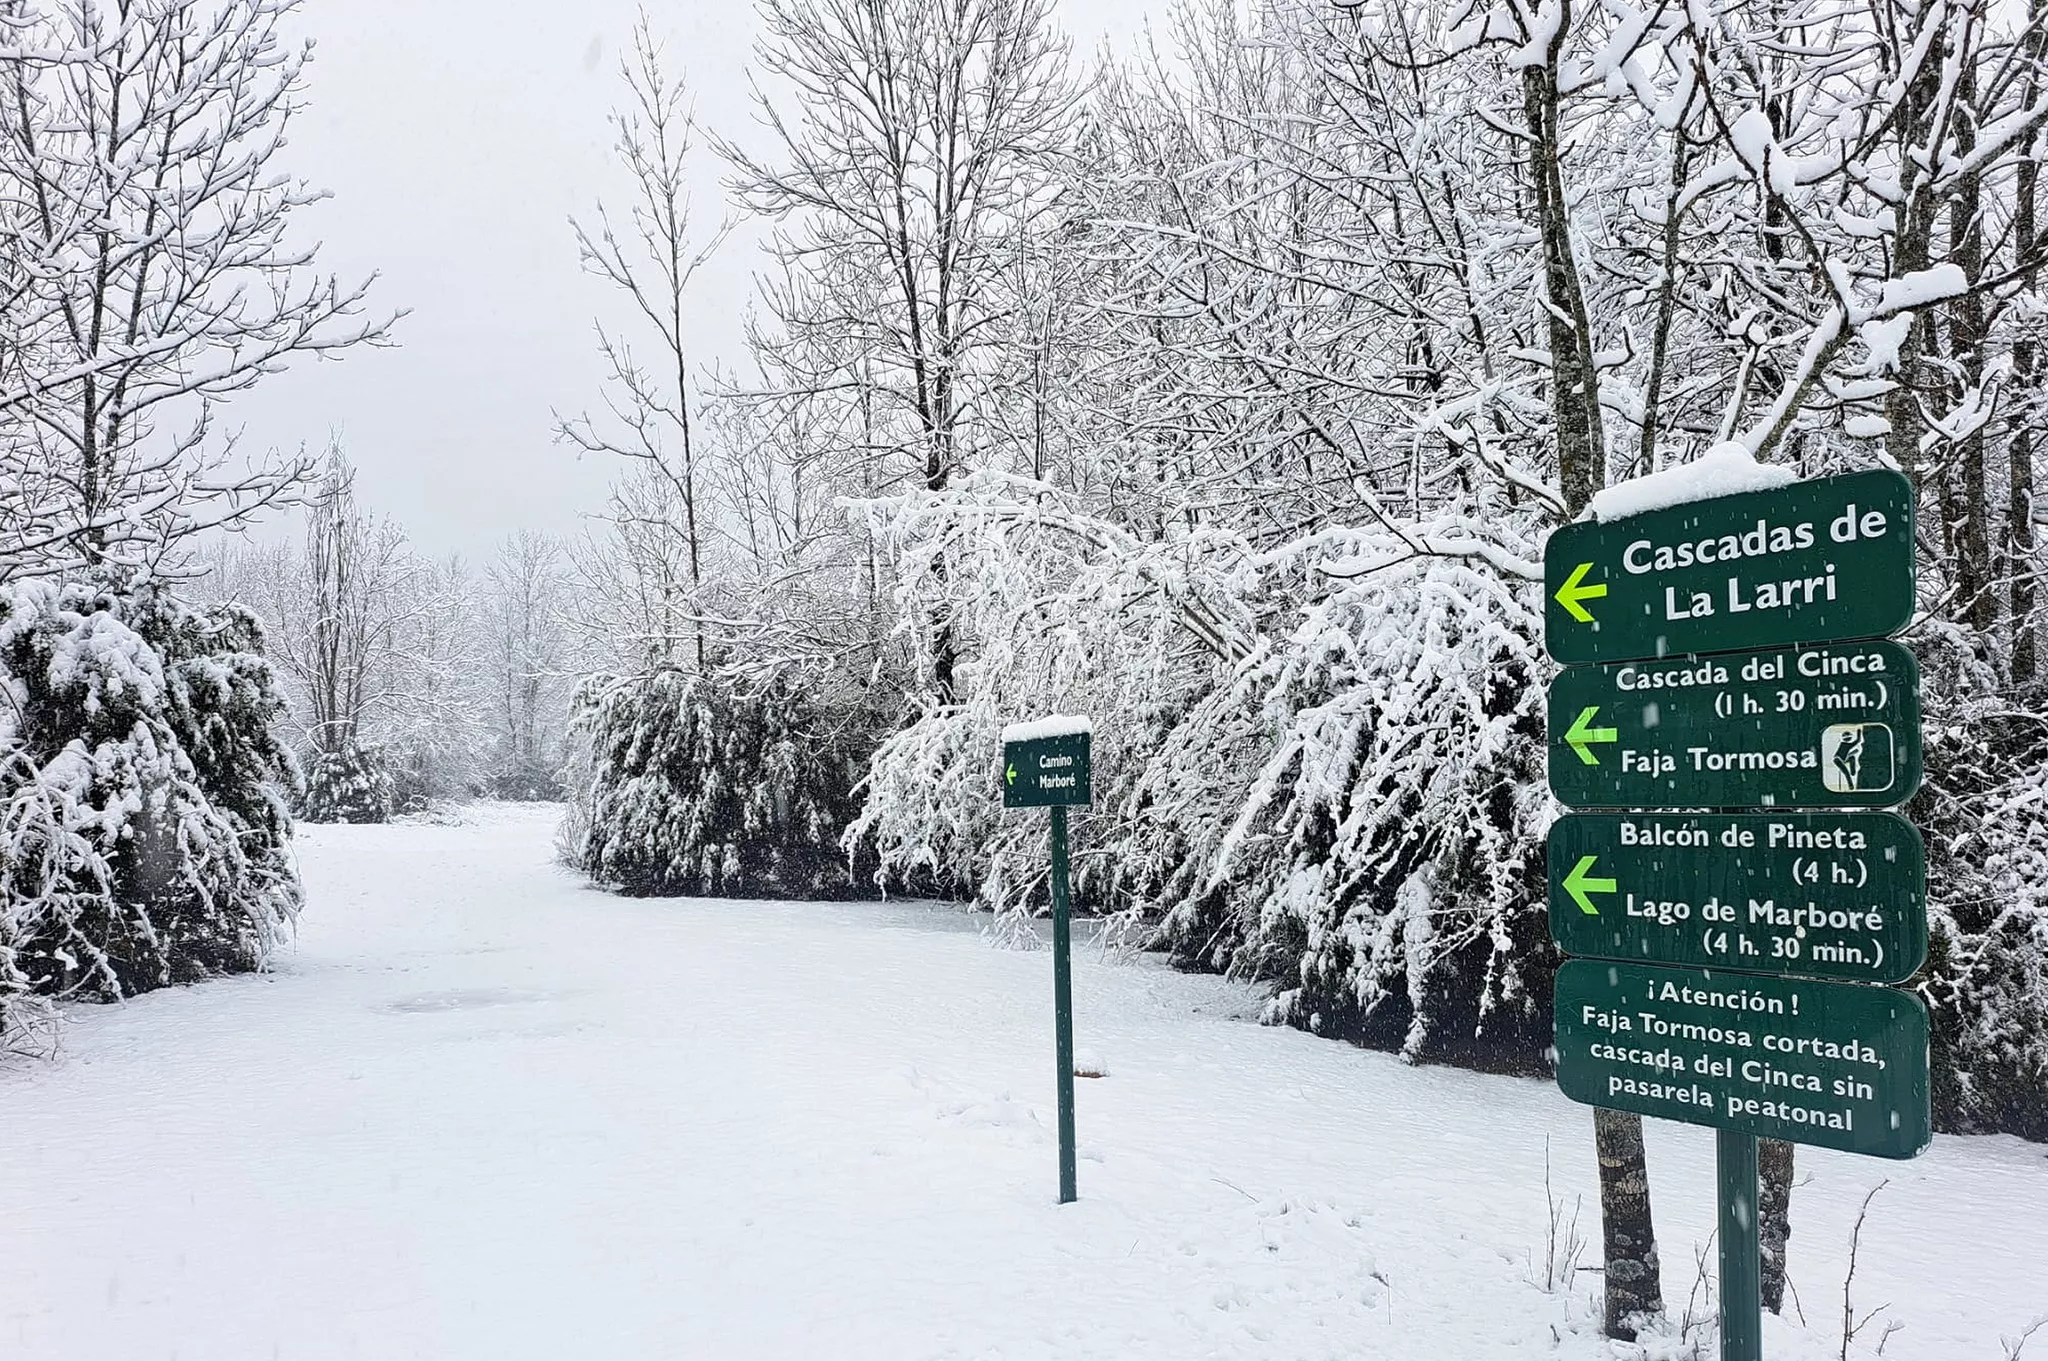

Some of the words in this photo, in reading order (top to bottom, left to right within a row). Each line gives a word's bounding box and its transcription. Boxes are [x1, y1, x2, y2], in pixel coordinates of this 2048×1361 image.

[1622, 519, 1814, 574] Cascadas
[1830, 504, 1887, 542] de
[1665, 586, 1715, 620] La
[1728, 563, 1836, 612] Larri
[1616, 663, 1729, 691] Cascada
[1741, 655, 1783, 682] del
[1797, 650, 1886, 677] Cinca
[1743, 693, 1764, 714] h.
[1776, 691, 1805, 711] 30
[1817, 681, 1887, 710] min.)
[1039, 753, 1072, 769] Camino
[1039, 772, 1076, 788] Marboré
[1622, 749, 1676, 778] Faja
[1687, 748, 1817, 771] Tormosa
[1620, 823, 1709, 847] Balcón
[1721, 824, 1754, 848] de
[1768, 825, 1866, 850] Pineta
[1792, 857, 1819, 887] (4
[1832, 860, 1868, 888] h.)
[1626, 894, 1690, 924] Lago
[1702, 898, 1736, 922] de
[1748, 900, 1883, 930] Marboré
[1703, 928, 1728, 956] (4
[1739, 933, 1760, 956] h.
[1772, 936, 1799, 958] 30
[1813, 939, 1884, 968] min.)
[1582, 1006, 1632, 1034] Faja
[1638, 1012, 1752, 1047] Tormosa
[1763, 1034, 1886, 1070] cortada,
[1590, 1042, 1686, 1072] cascada
[1694, 1056, 1732, 1078] del
[1741, 1060, 1822, 1092] Cinca
[1833, 1076, 1873, 1099] sin
[1608, 1074, 1714, 1108] pasarela
[1728, 1094, 1852, 1130] peatonal
